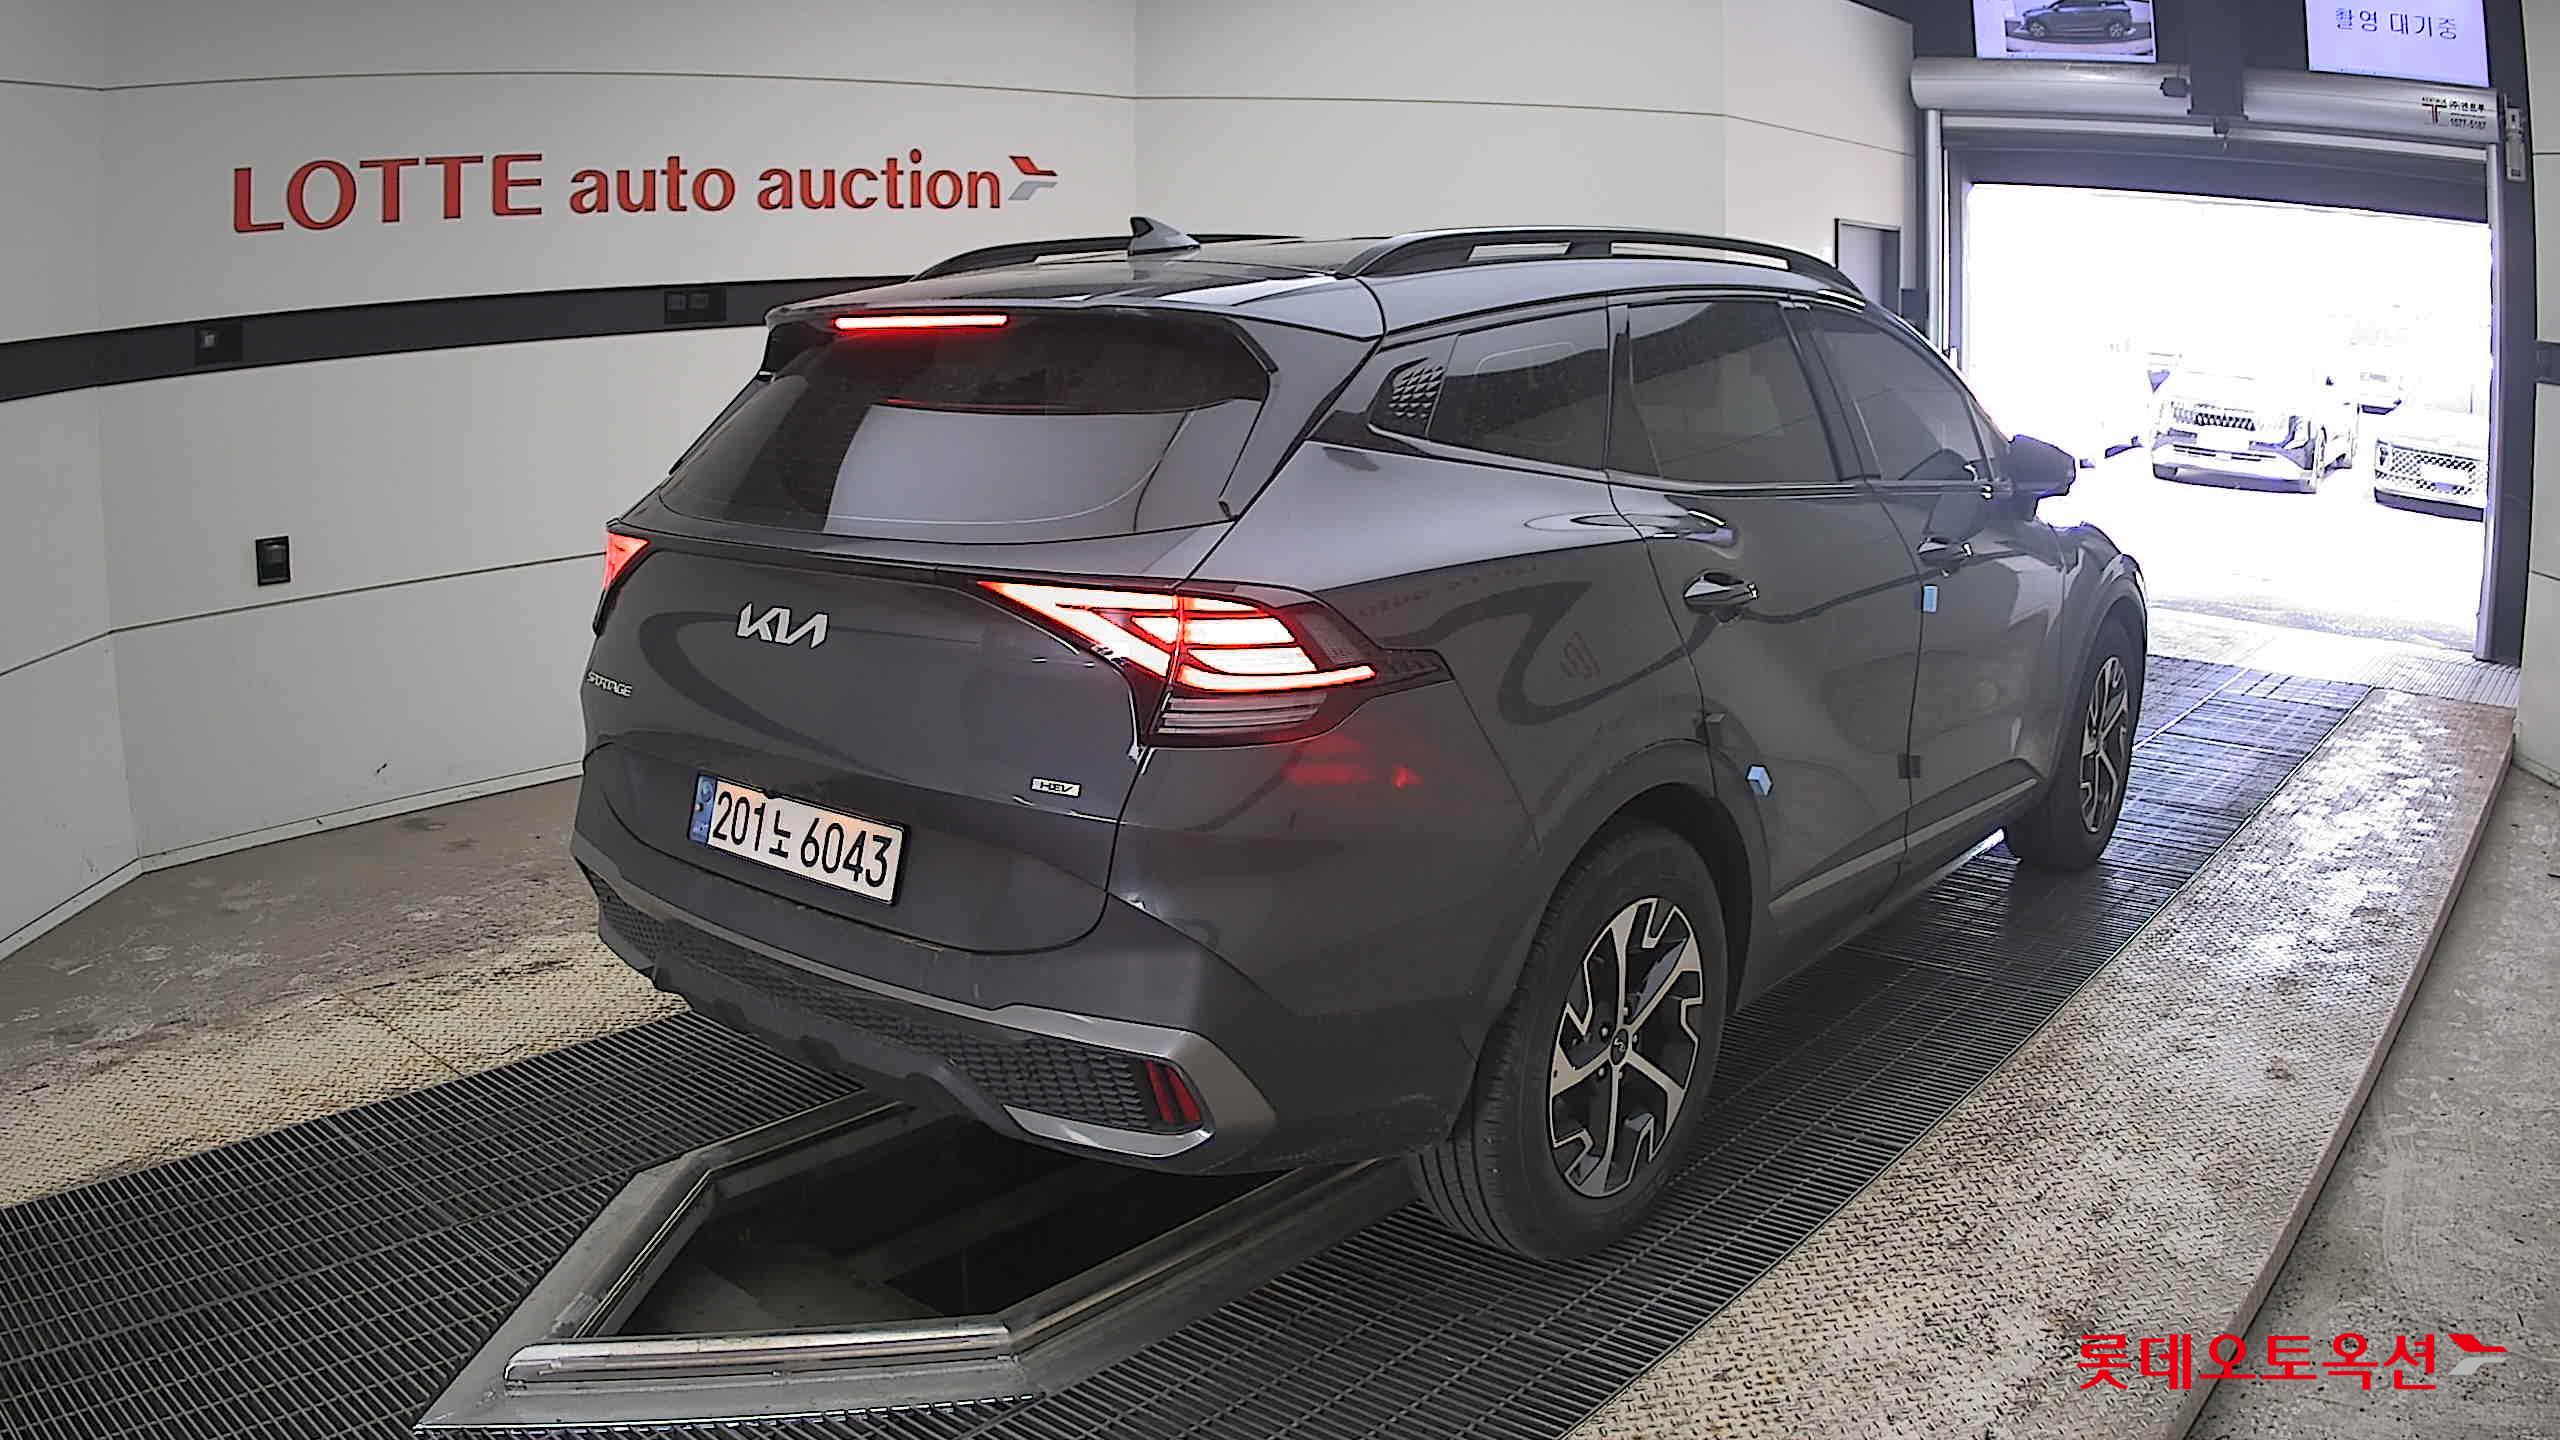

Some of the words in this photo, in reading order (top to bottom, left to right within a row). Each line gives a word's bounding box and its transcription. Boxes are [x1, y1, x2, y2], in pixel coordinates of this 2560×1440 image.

[2389, 12, 2457, 40] 대기중
[233, 153, 542, 233] LOTTE
[569, 155, 737, 215] auto
[757, 148, 1001, 212] auction
[737, 602, 829, 649] KIA
[1037, 780, 1077, 794] HEV
[712, 790, 792, 859] 201노
[800, 817, 893, 888] 6043
